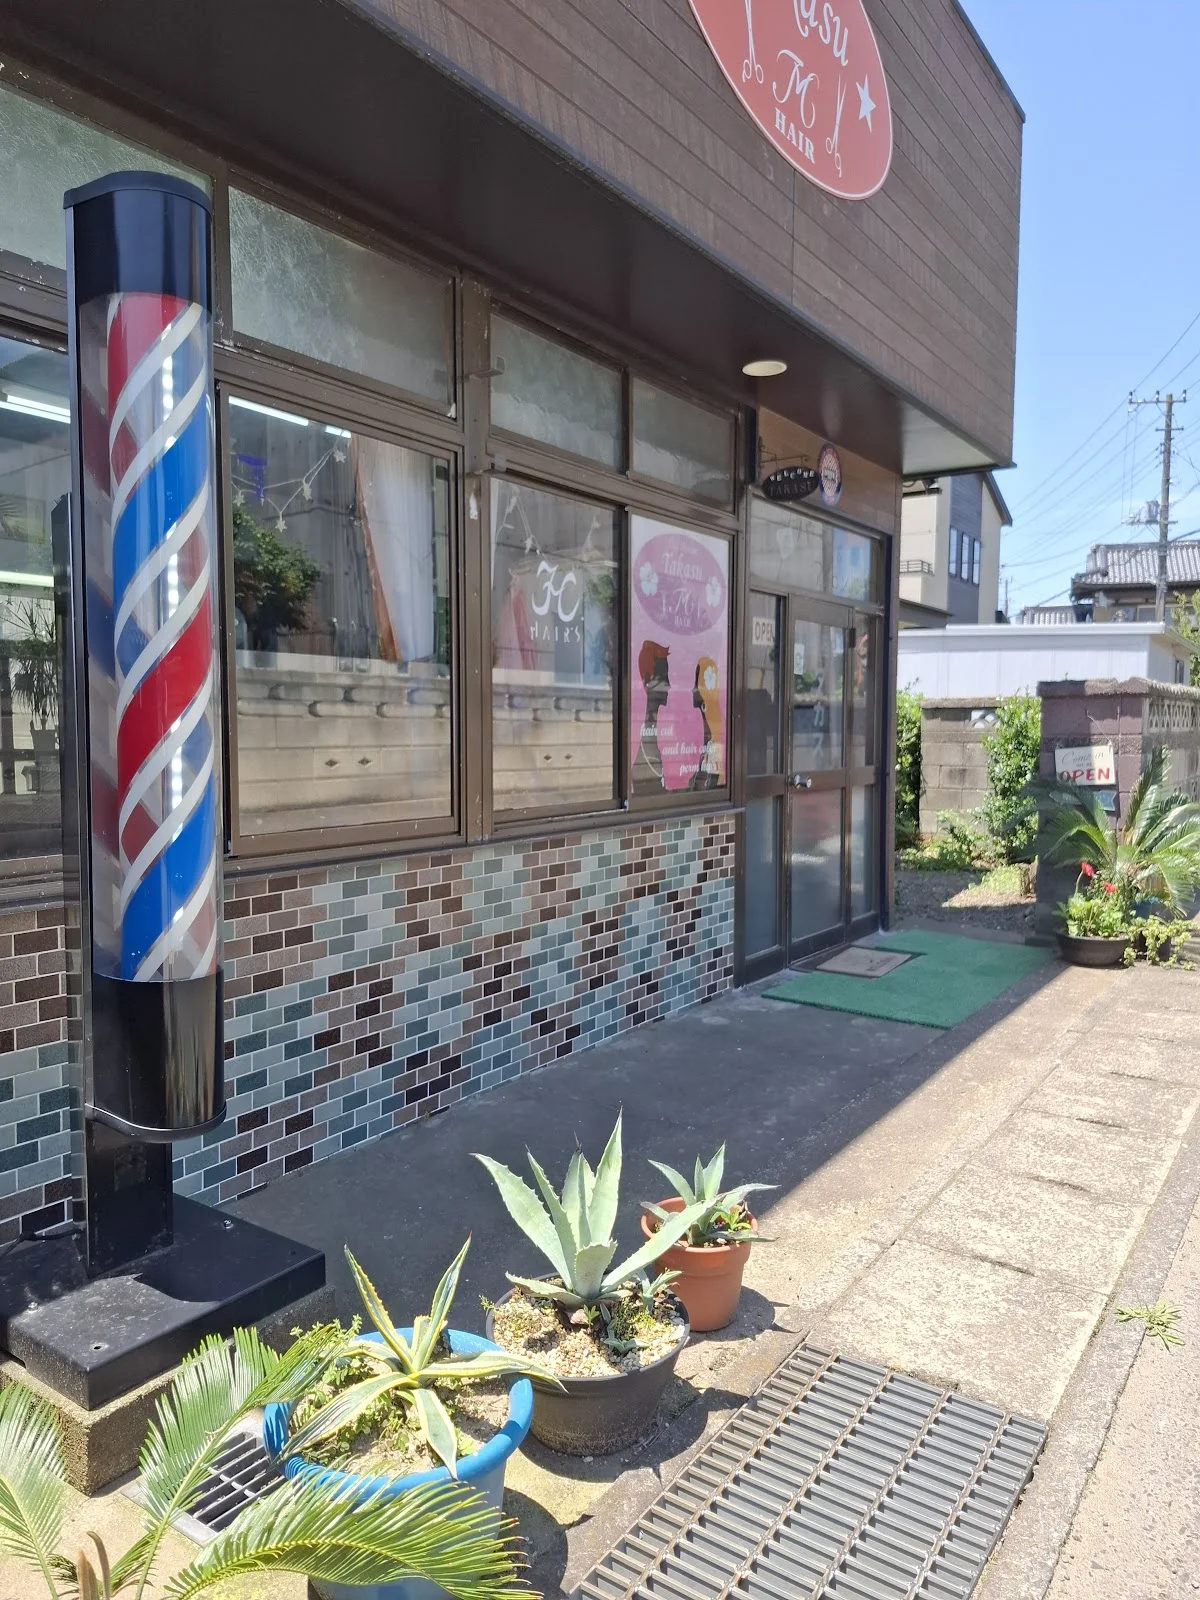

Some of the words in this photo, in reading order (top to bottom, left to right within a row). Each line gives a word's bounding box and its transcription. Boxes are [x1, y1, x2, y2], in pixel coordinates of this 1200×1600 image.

[774, 106, 816, 165] HAIR
[769, 468, 815, 482] WELCOME
[661, 552, 703, 583] Takasu
[754, 621, 775, 642] OPEN
[640, 722, 659, 737] hair
[660, 724, 673, 736] cut
[662, 742, 679, 756] and
[680, 742, 698, 755] hair
[1062, 750, 1091, 765] Come
[1059, 767, 1110, 782] OPEN
